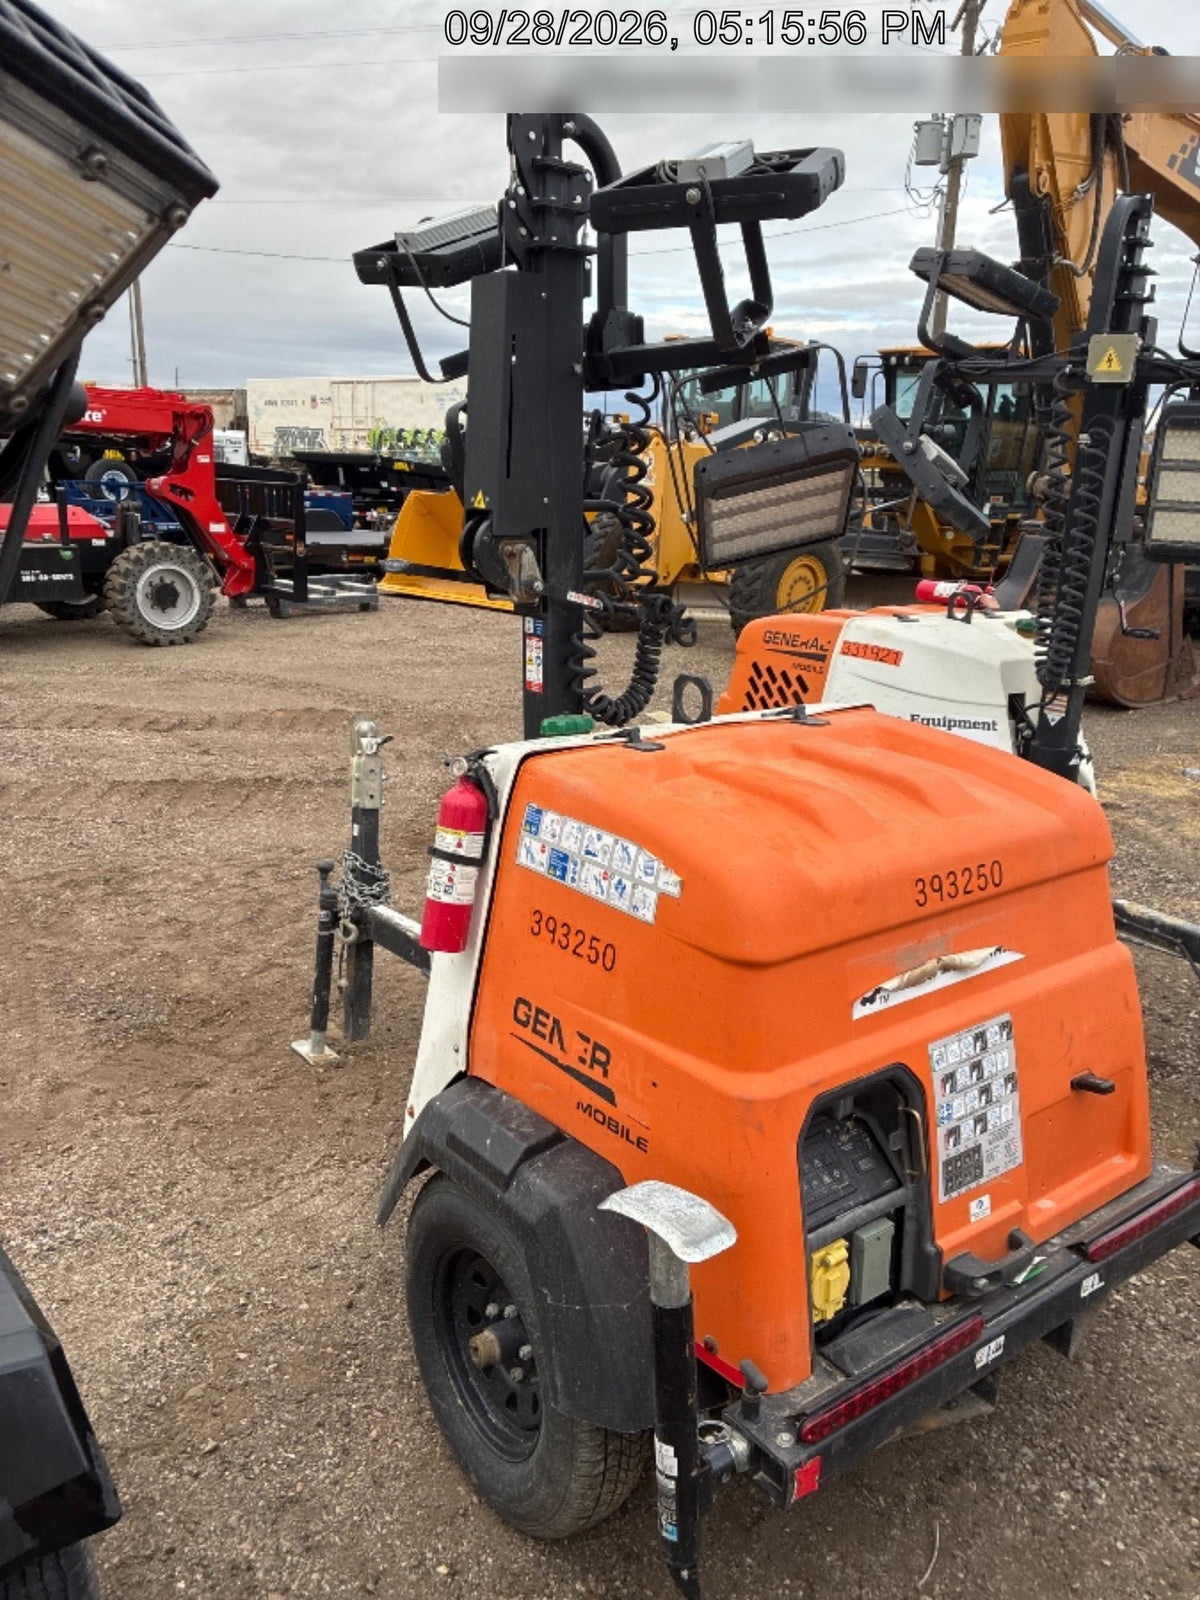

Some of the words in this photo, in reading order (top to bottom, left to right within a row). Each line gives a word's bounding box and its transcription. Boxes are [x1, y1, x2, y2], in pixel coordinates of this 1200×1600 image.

[841, 640, 902, 666] 331921
[909, 713, 998, 732] Equipment
[915, 859, 1003, 907] 393250
[531, 909, 616, 972] 393250
[576, 1101, 649, 1153] MOBILE
